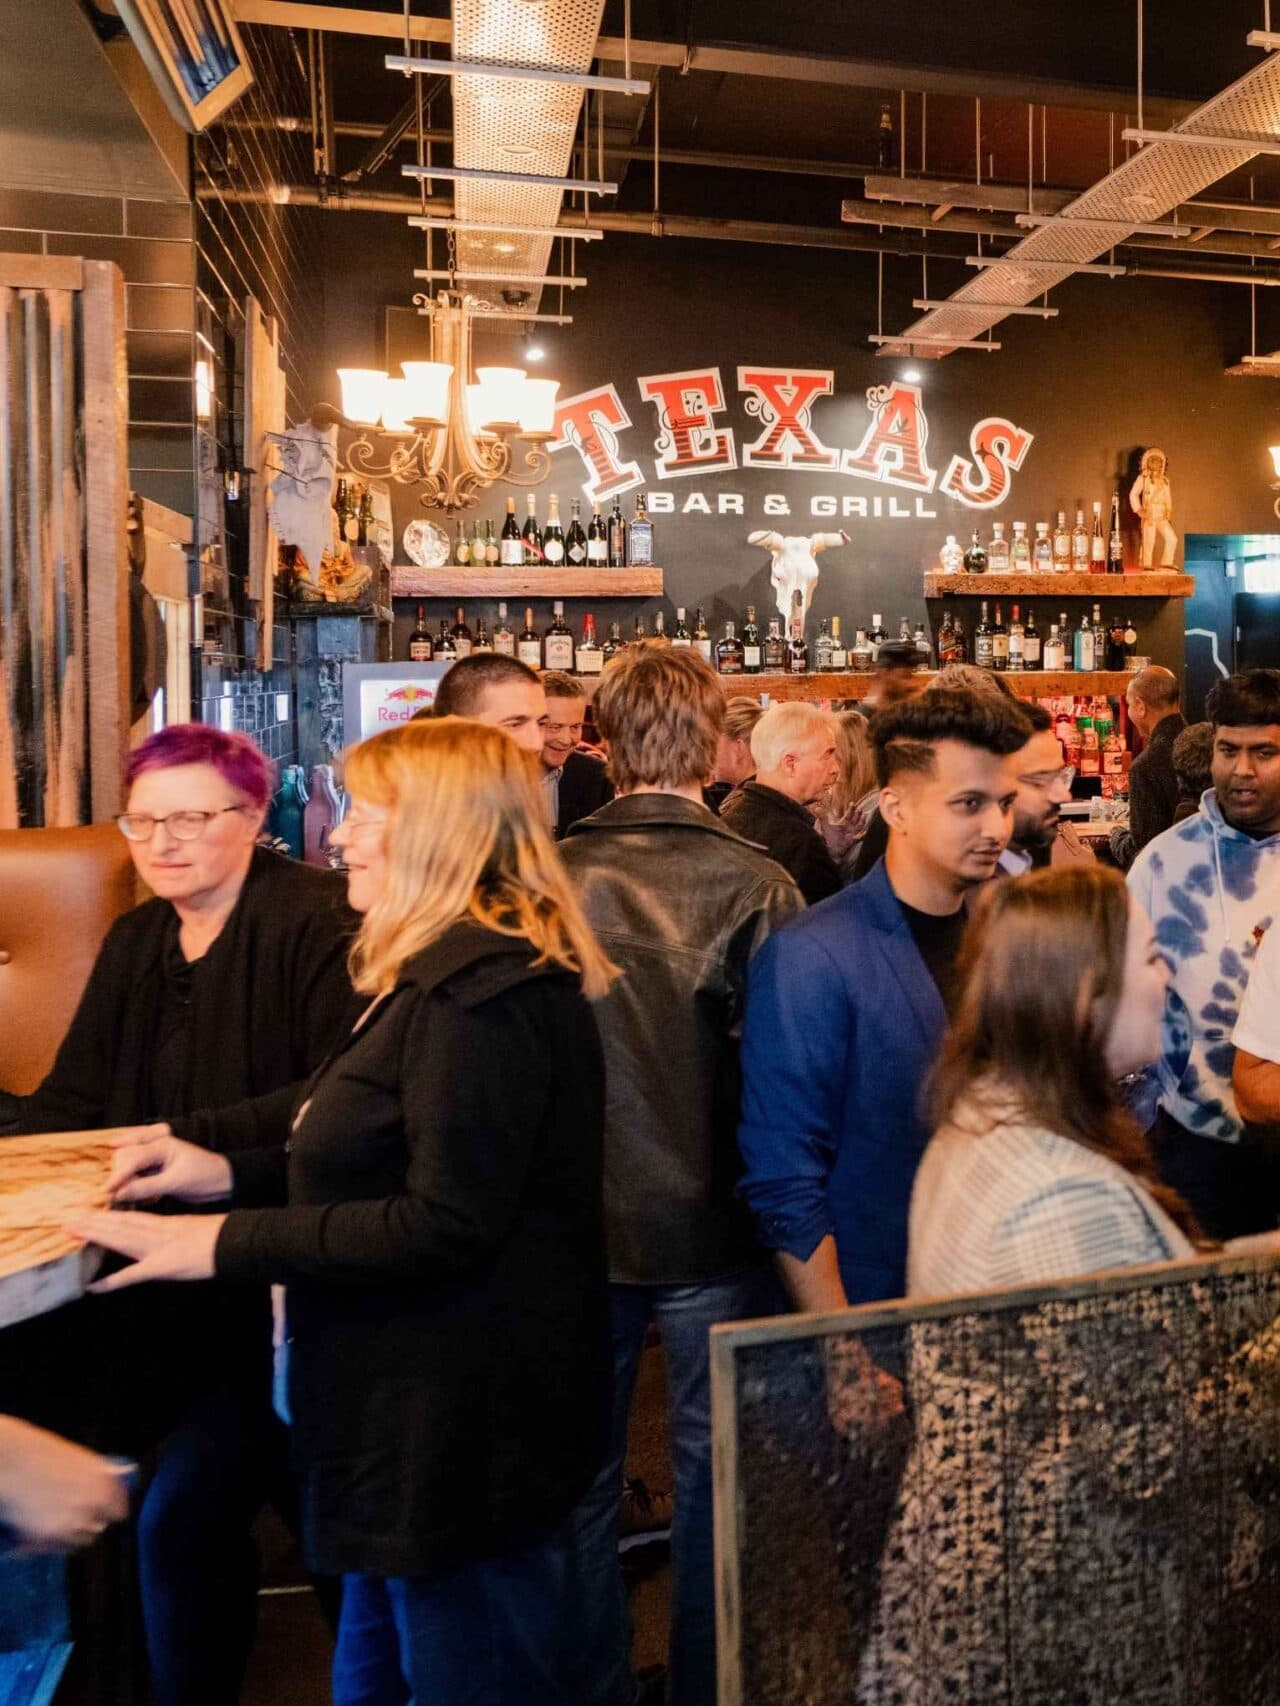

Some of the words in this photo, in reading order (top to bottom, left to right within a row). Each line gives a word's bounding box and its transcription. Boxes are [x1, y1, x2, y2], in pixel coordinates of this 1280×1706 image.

[546, 366, 1034, 508] TEXAS
[647, 492, 744, 514] BAR
[763, 494, 791, 516] &
[810, 495, 937, 518] GRILL
[377, 706, 410, 721] Red
